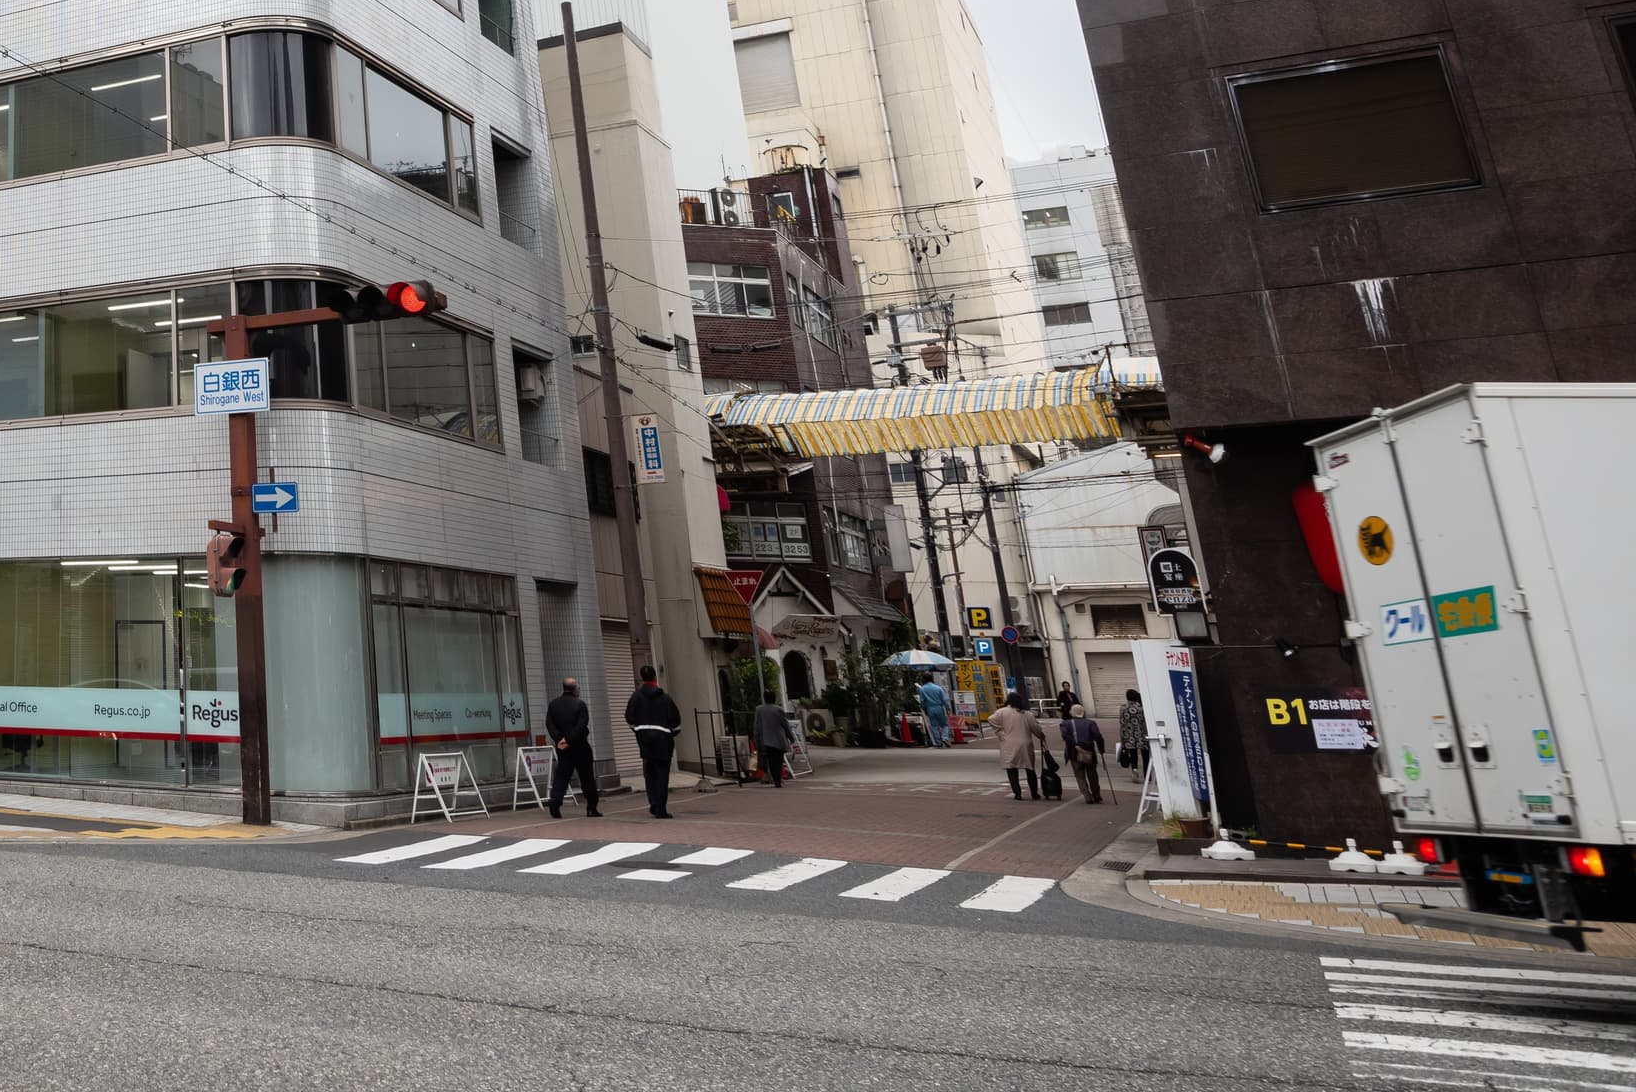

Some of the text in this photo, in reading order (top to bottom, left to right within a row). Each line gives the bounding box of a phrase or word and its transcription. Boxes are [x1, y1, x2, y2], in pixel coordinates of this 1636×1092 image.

[203, 369, 260, 393] 白銀西
[200, 391, 264, 406] Shirogane West
[734, 577, 757, 585] 止まれ
[1385, 604, 1425, 639] クール
[979, 641, 989, 653] P
[1165, 651, 1190, 668] テナント募集
[9, 701, 38, 713] Office
[94, 704, 151, 719] Regus.co.jp
[465, 707, 492, 720] Co-working
[1265, 698, 1308, 725] B1
[192, 704, 238, 728] Regus
[413, 708, 453, 723] Meeting Spaces
[503, 705, 522, 725] Regus
